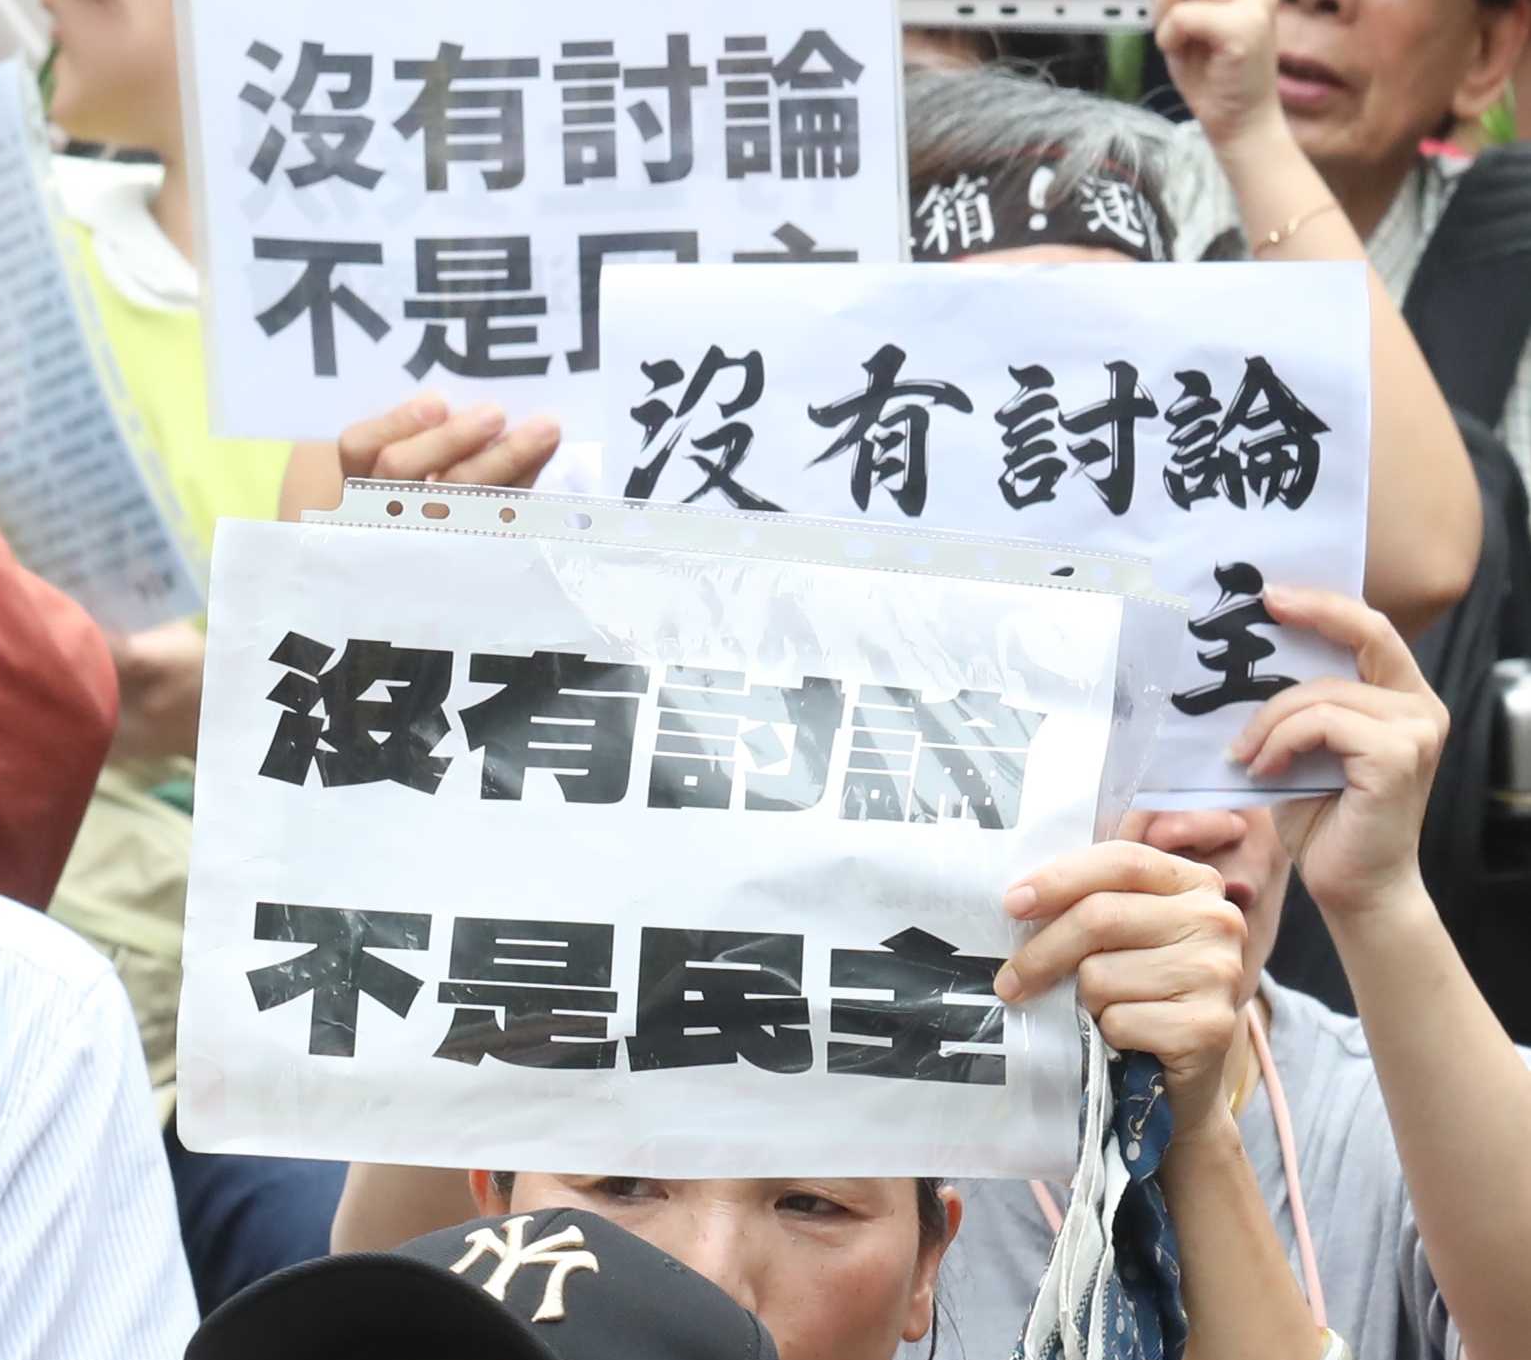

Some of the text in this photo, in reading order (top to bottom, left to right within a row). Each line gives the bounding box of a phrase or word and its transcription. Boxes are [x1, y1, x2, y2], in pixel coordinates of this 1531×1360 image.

[237, 29, 866, 194] 沒有討論
[624, 342, 1334, 518] 沒有討論
[1171, 561, 1304, 717] 主
[257, 630, 1050, 831] 沒有討論
[245, 900, 1008, 1087] 不是民主
[449, 1215, 600, 1324] NY
